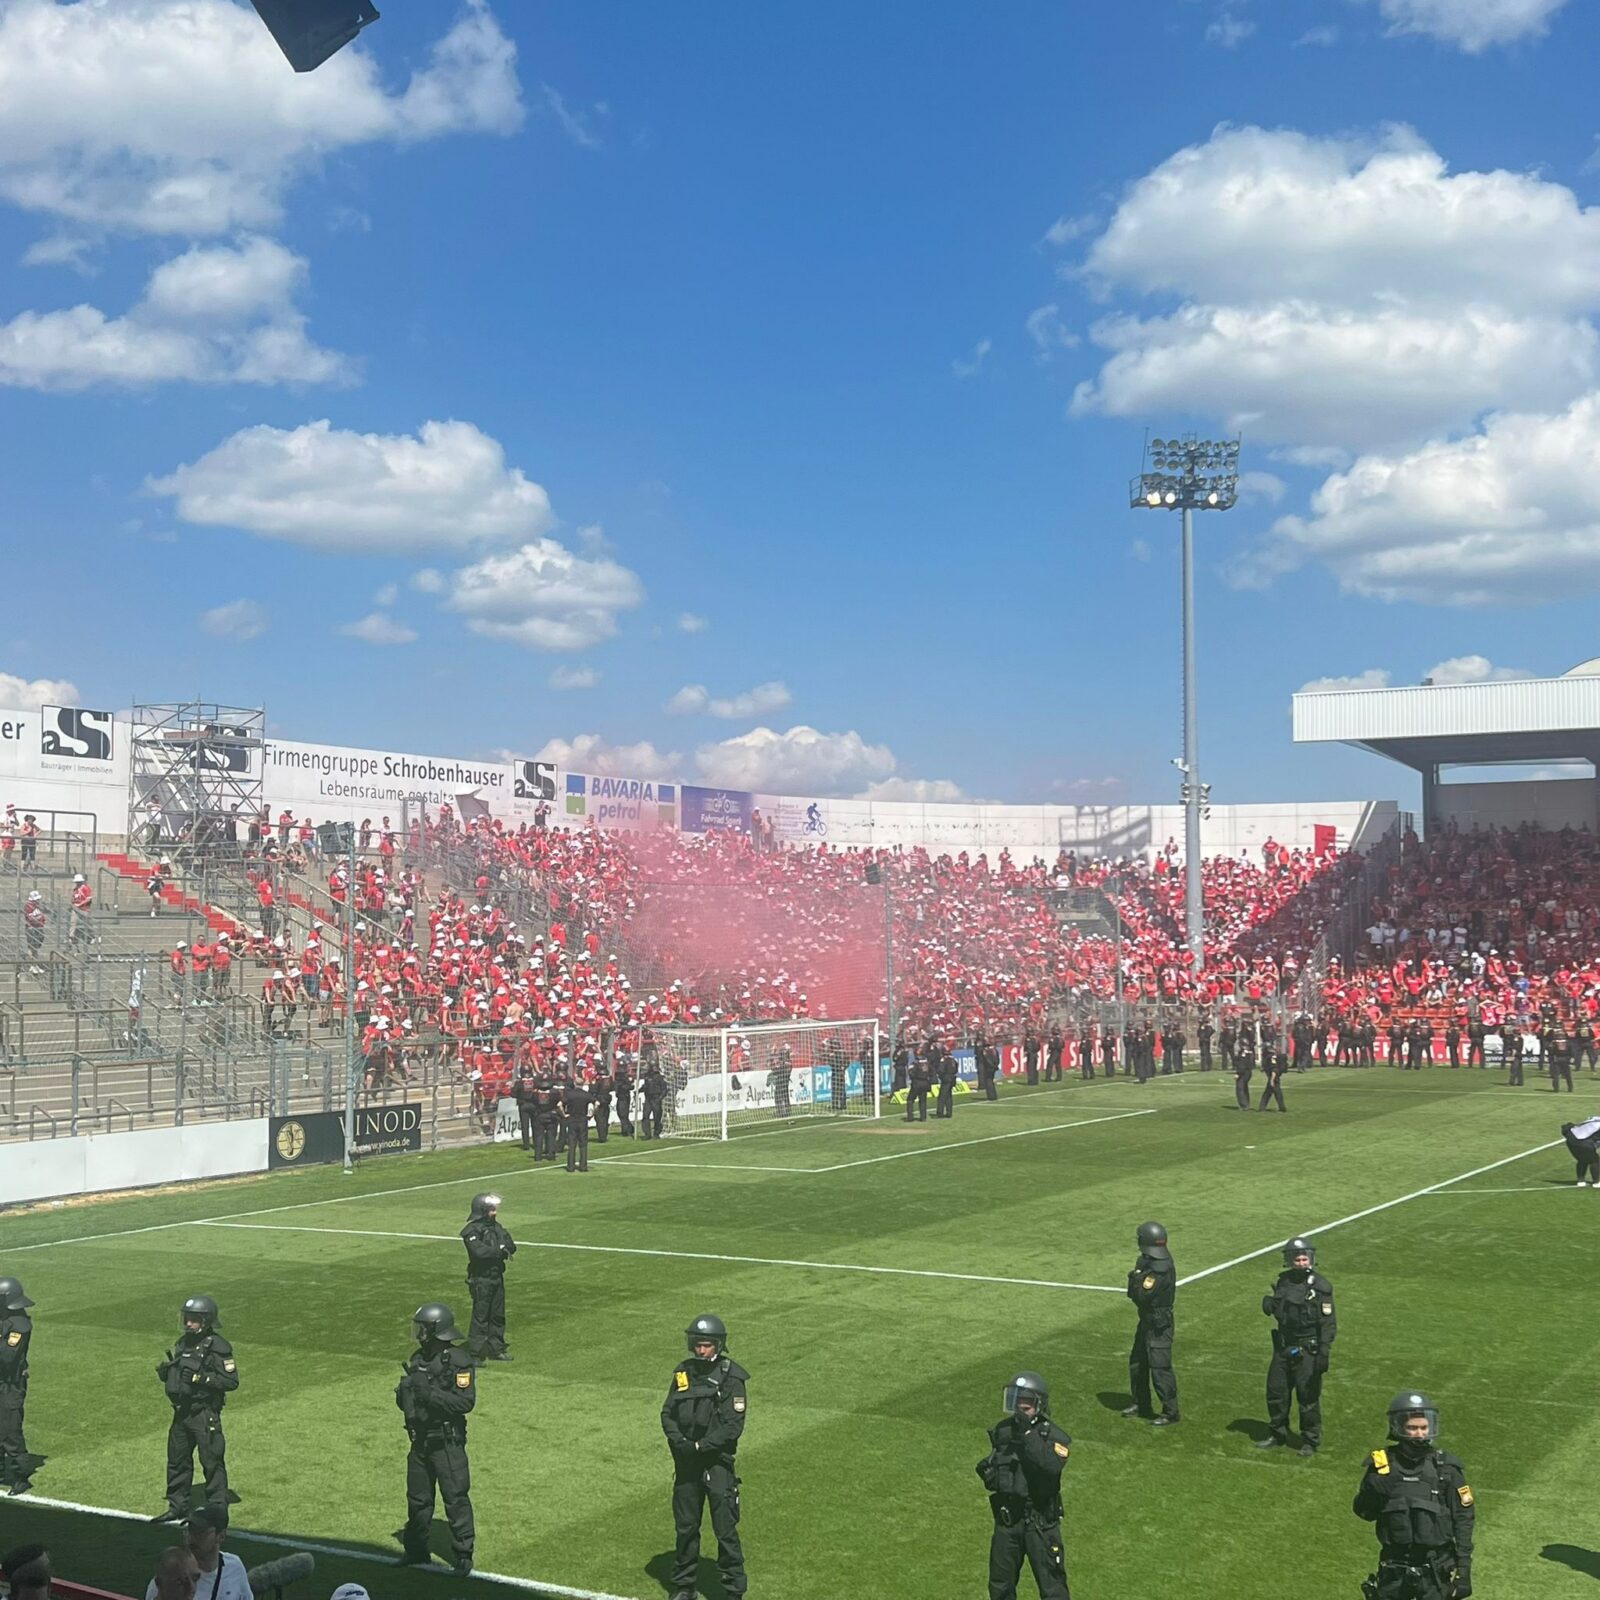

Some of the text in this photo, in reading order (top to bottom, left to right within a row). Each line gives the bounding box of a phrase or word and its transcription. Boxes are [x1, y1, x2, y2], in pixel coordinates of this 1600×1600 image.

[263, 743, 505, 787] Firmengruppe Schrobenhauser
[319, 779, 454, 806] Lebensräume gestalte
[592, 776, 653, 801] BAVARIA
[598, 801, 641, 823] petrol
